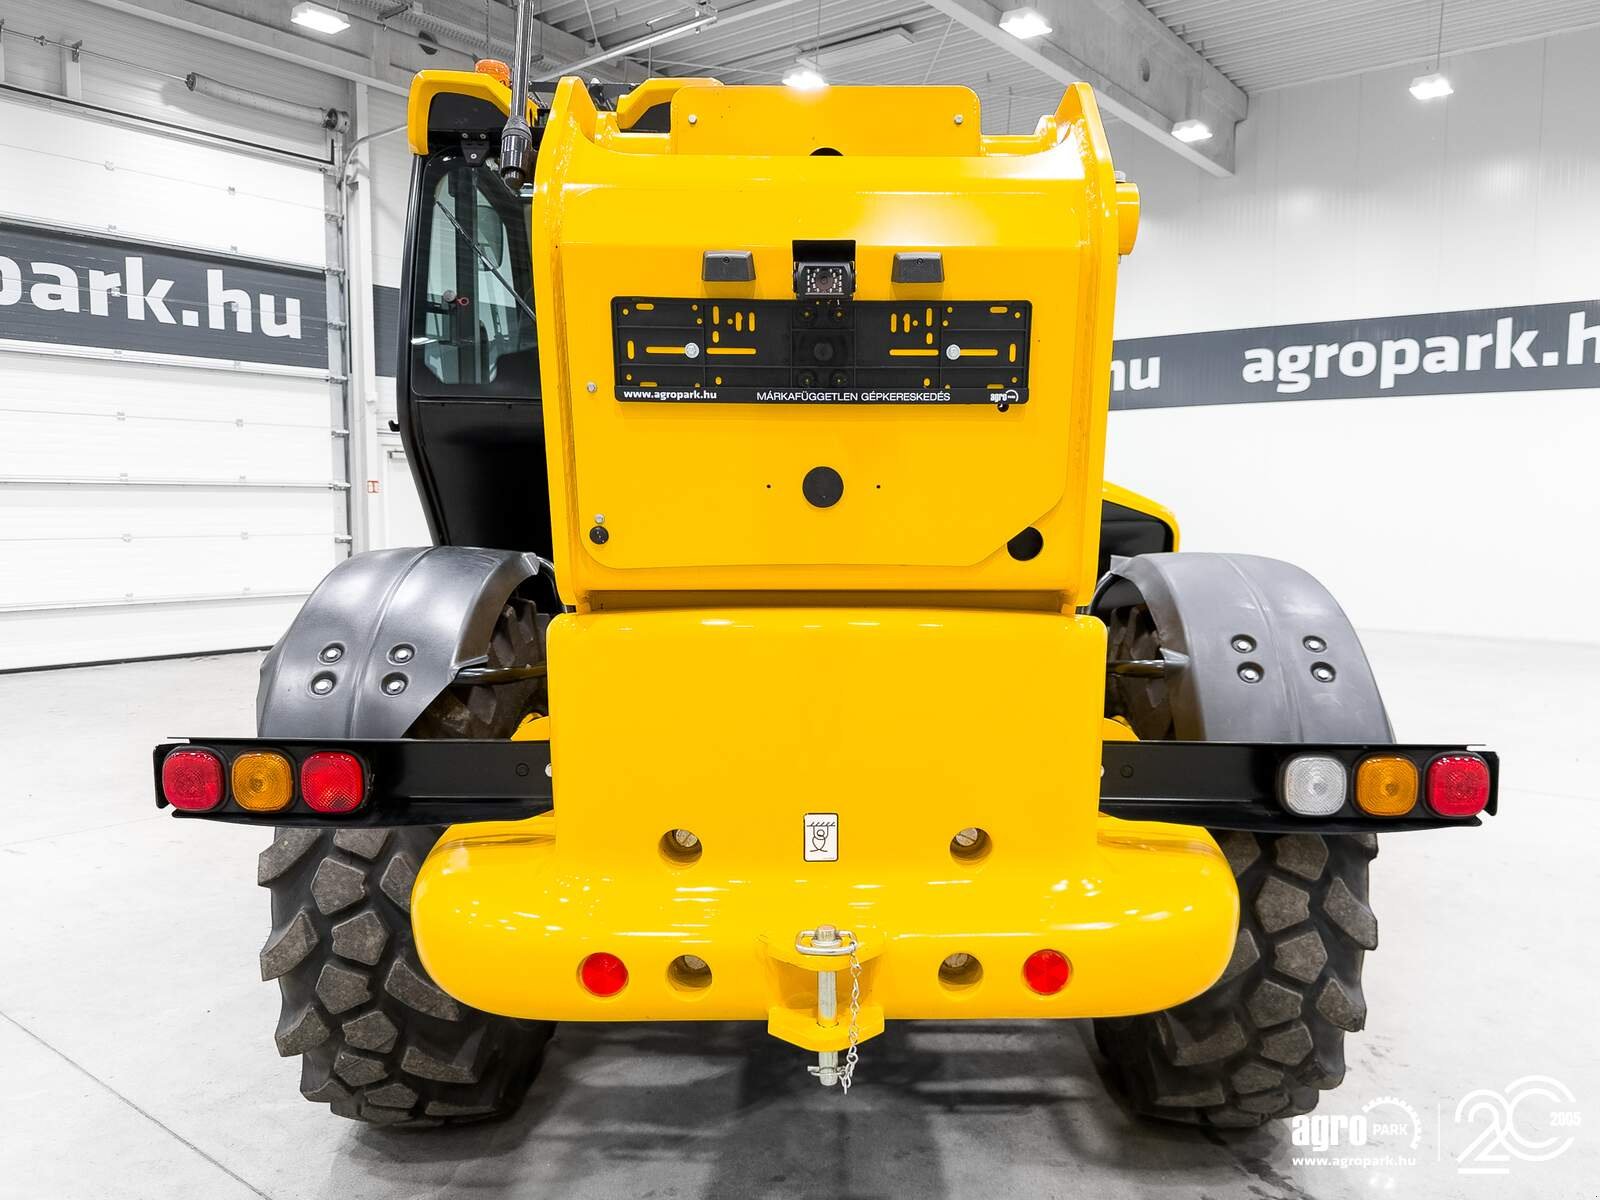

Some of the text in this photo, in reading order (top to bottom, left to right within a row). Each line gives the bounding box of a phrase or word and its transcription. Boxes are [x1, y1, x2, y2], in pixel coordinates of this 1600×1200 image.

[623, 389, 717, 401] www.agropark.hu
[756, 389, 951, 402] MÁRKAFÜGGETLEN GÉPKERESKEDÉS
